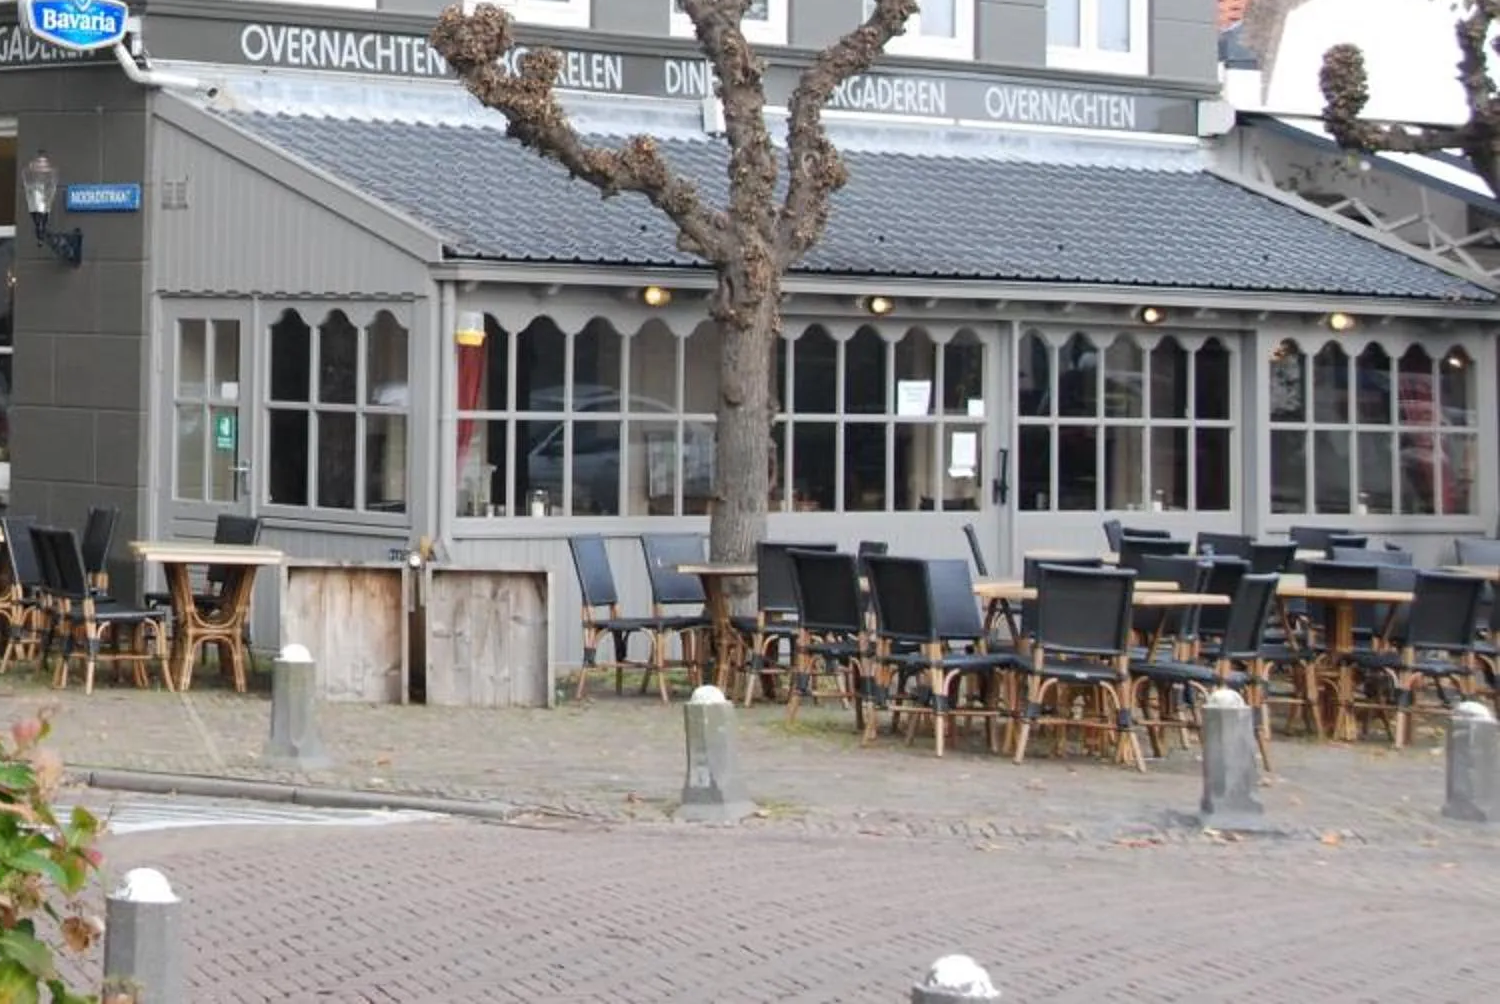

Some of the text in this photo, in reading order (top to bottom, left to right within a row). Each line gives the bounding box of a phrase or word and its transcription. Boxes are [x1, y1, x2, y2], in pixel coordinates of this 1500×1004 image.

[42, 8, 117, 32] Bavaria
[241, 24, 1136, 129] OVERNACHTEN BOELEN DINE RGADEREN OVERNACHTEN
